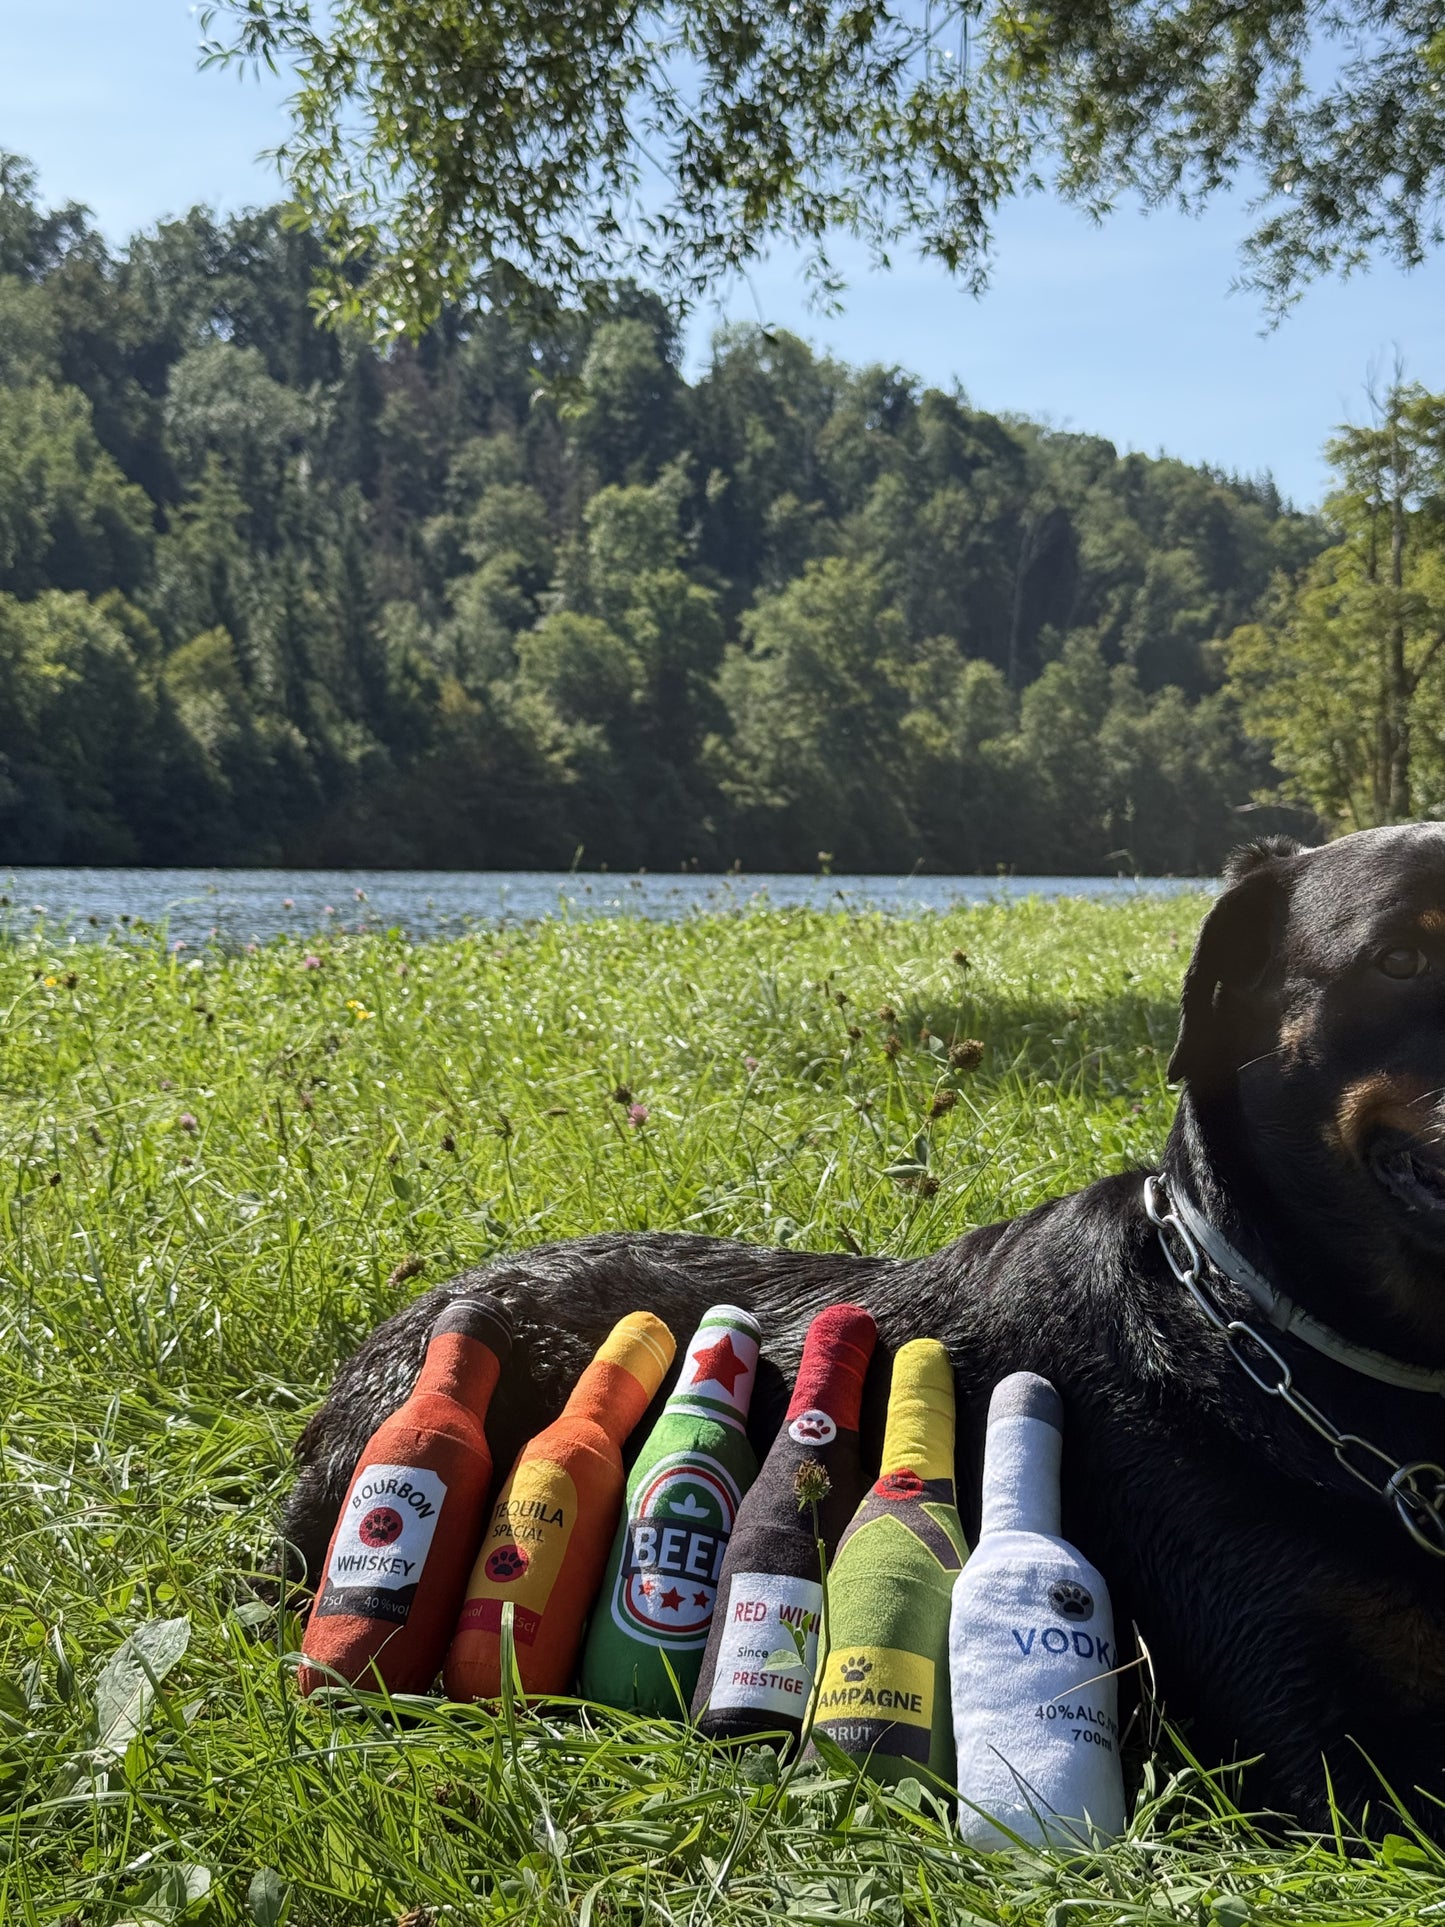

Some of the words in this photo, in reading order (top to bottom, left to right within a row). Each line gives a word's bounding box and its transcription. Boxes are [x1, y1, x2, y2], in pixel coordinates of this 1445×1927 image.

[352, 1478, 436, 1520] BOURBON
[494, 1499, 564, 1528] TEQUILA
[491, 1523, 545, 1543] SPECIAL
[337, 1554, 416, 1577] WHISKEY
[321, 1594, 343, 1607] 75cl
[733, 1601, 768, 1623] RED
[737, 1646, 769, 1659] Since
[732, 1671, 804, 1696] PRESTIGE
[818, 1686, 923, 1714] AMPAGNE
